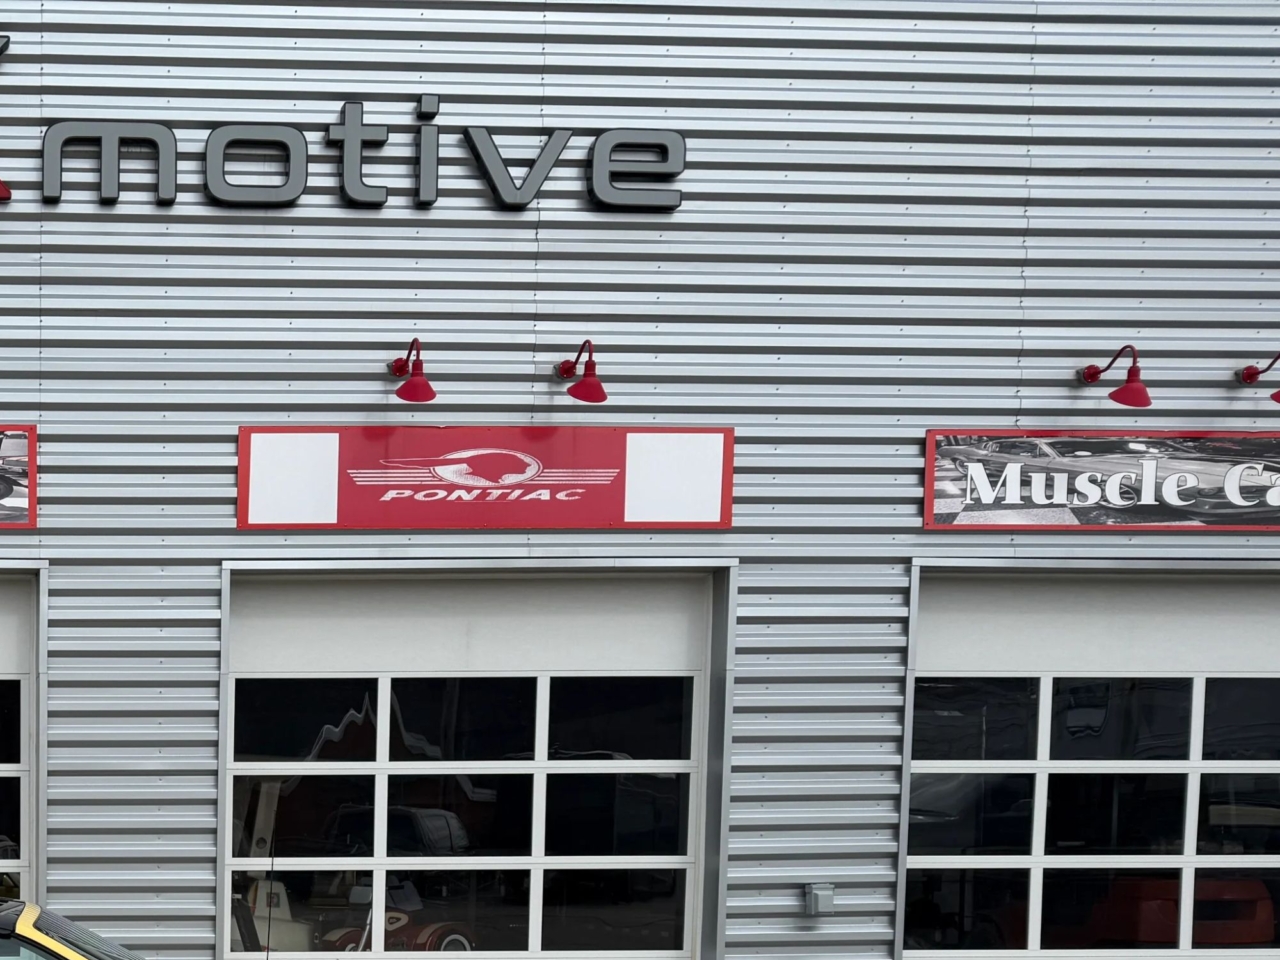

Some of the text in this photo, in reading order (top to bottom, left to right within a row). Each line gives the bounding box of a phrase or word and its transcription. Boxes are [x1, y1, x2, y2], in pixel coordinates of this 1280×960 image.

[41, 94, 685, 211] motive
[379, 489, 586, 501] PONTIAC
[961, 459, 1200, 507] Muscle
